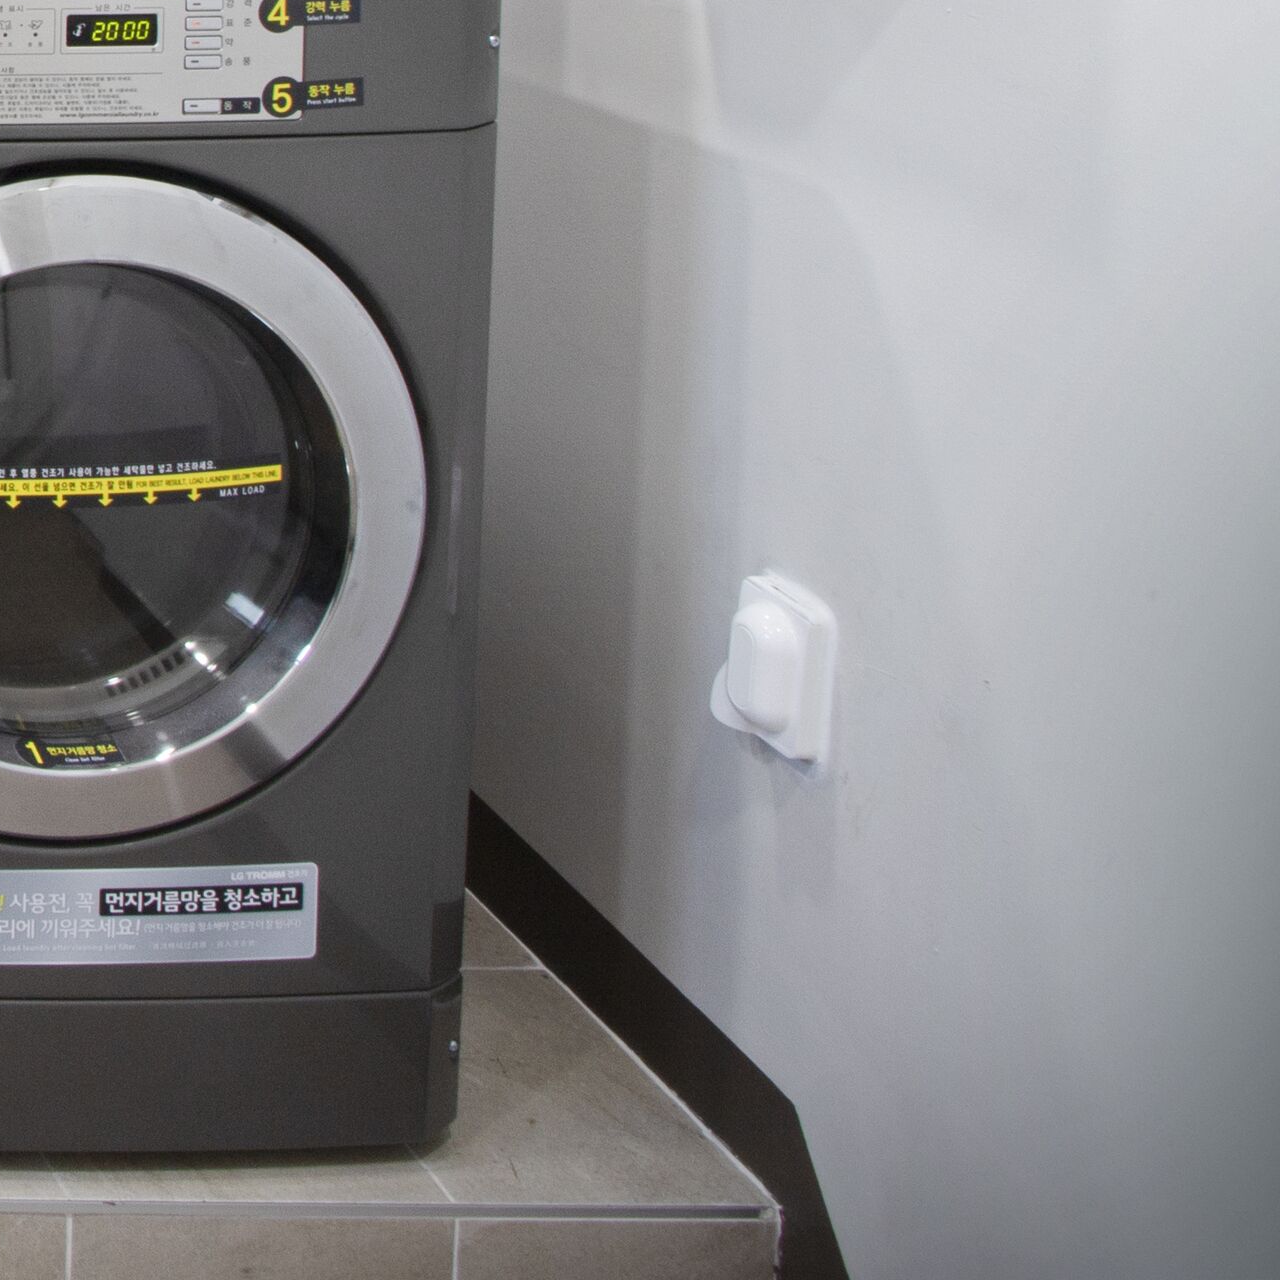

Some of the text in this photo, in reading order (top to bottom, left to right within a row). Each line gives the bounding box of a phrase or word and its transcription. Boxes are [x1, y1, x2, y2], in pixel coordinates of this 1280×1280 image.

[306, 1, 326, 13] 강력
[330, 0, 351, 12] 누름
[272, 83, 355, 112] 5 동작 누름
[219, 485, 265, 498] MAX LOAD
[25, 741, 44, 764] 1
[230, 871, 286, 881] LG TROMM
[9, 893, 71, 915] 사용전,
[75, 893, 95, 913] 꼭
[105, 889, 219, 913] 먼지거름망을
[224, 887, 299, 911] 청소하고
[40, 918, 140, 940] 끼워주세요!
